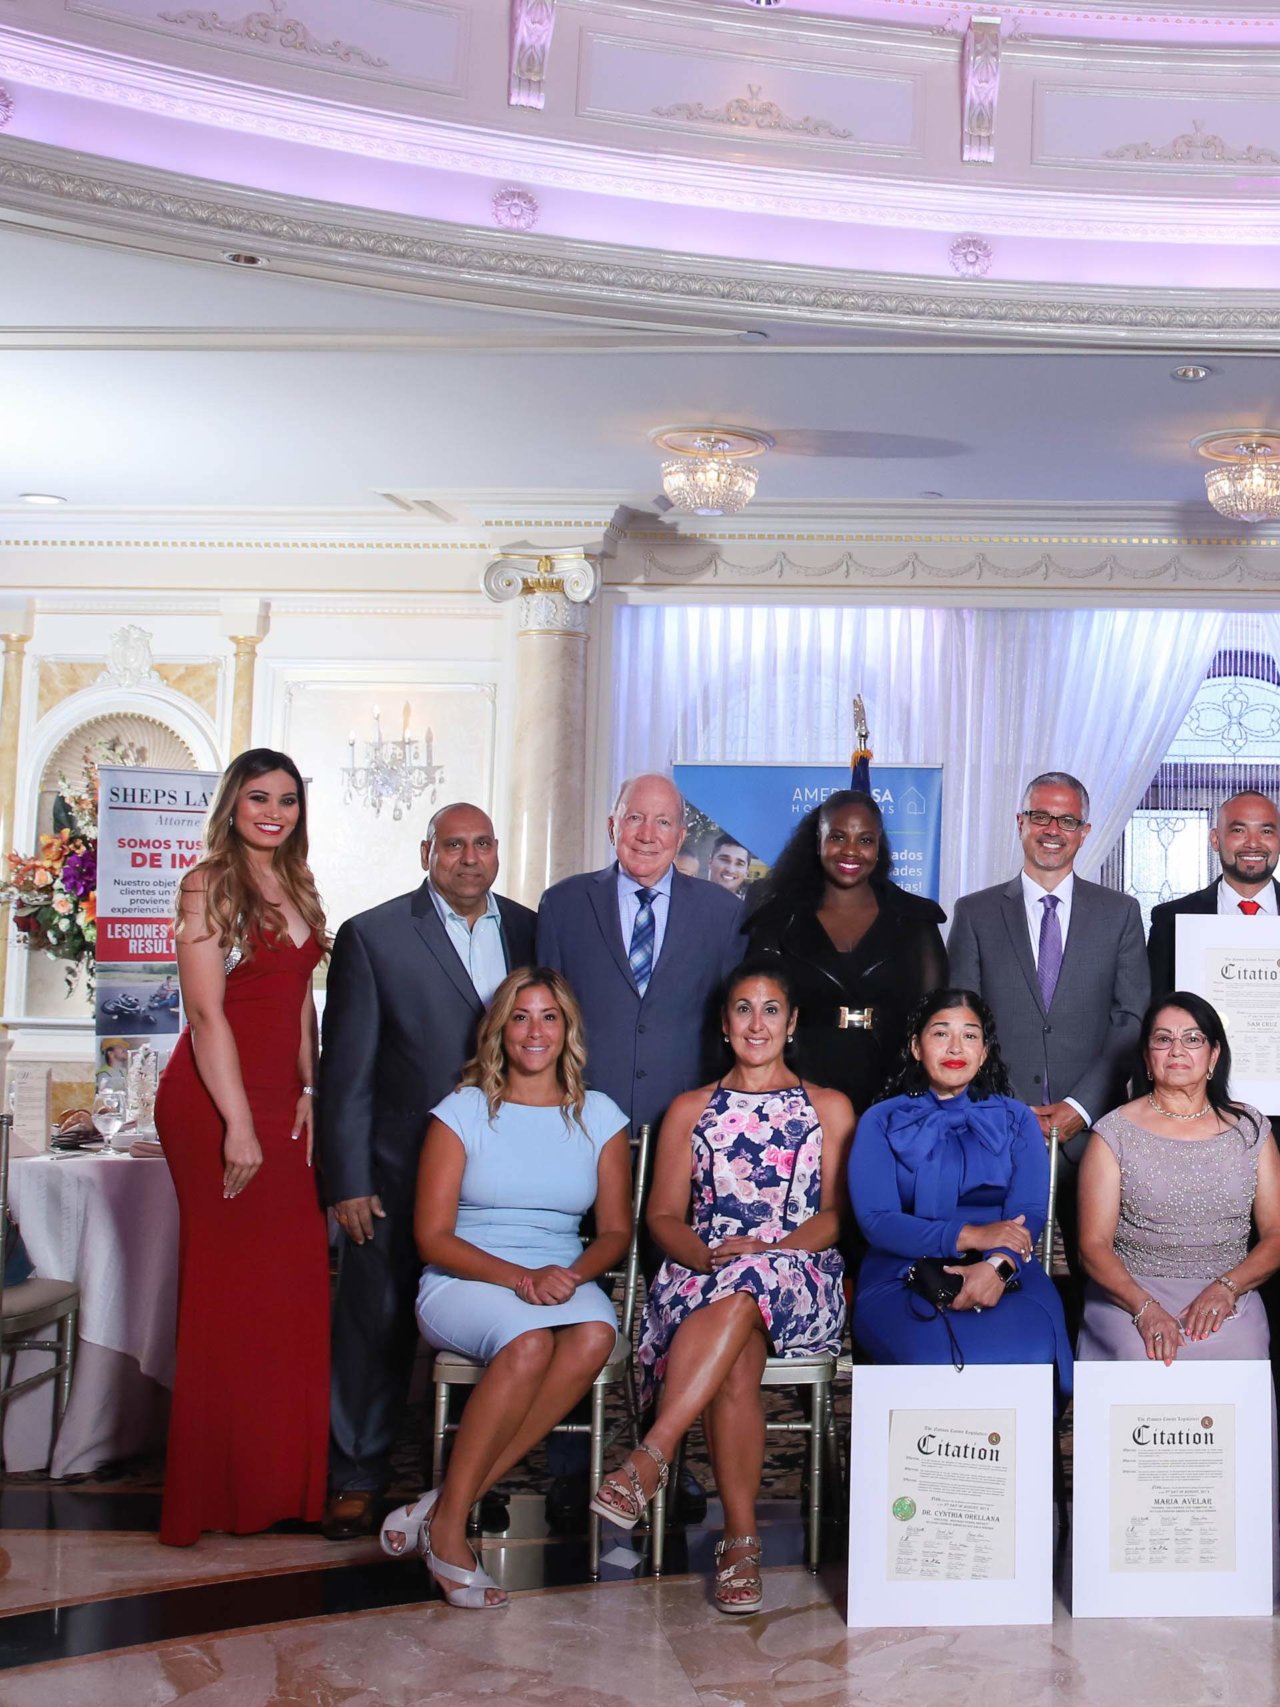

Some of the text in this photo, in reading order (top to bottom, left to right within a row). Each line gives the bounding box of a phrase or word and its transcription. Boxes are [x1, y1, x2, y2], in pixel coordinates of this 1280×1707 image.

[109, 786, 213, 807] SHEPS LA
[155, 814, 201, 828] Attorne
[117, 838, 204, 851] SOMOS TUS
[131, 852, 198, 869] DE IM
[891, 849, 924, 861] ados
[891, 865, 923, 877] ades
[113, 878, 177, 889] Nuestro objet
[119, 887, 157, 896] clientes
[129, 897, 170, 906] proviene
[110, 906, 165, 915] experiencia
[107, 923, 168, 939] LESIONES
[128, 938, 176, 954] RESULT
[1132, 1424, 1215, 1446] Citation
[917, 1433, 1000, 1462] Citation
[1181, 1497, 1212, 1505] AVELAR
[934, 1510, 963, 1519] CYNTHIA
[964, 1513, 1000, 1522] ORELLANA
